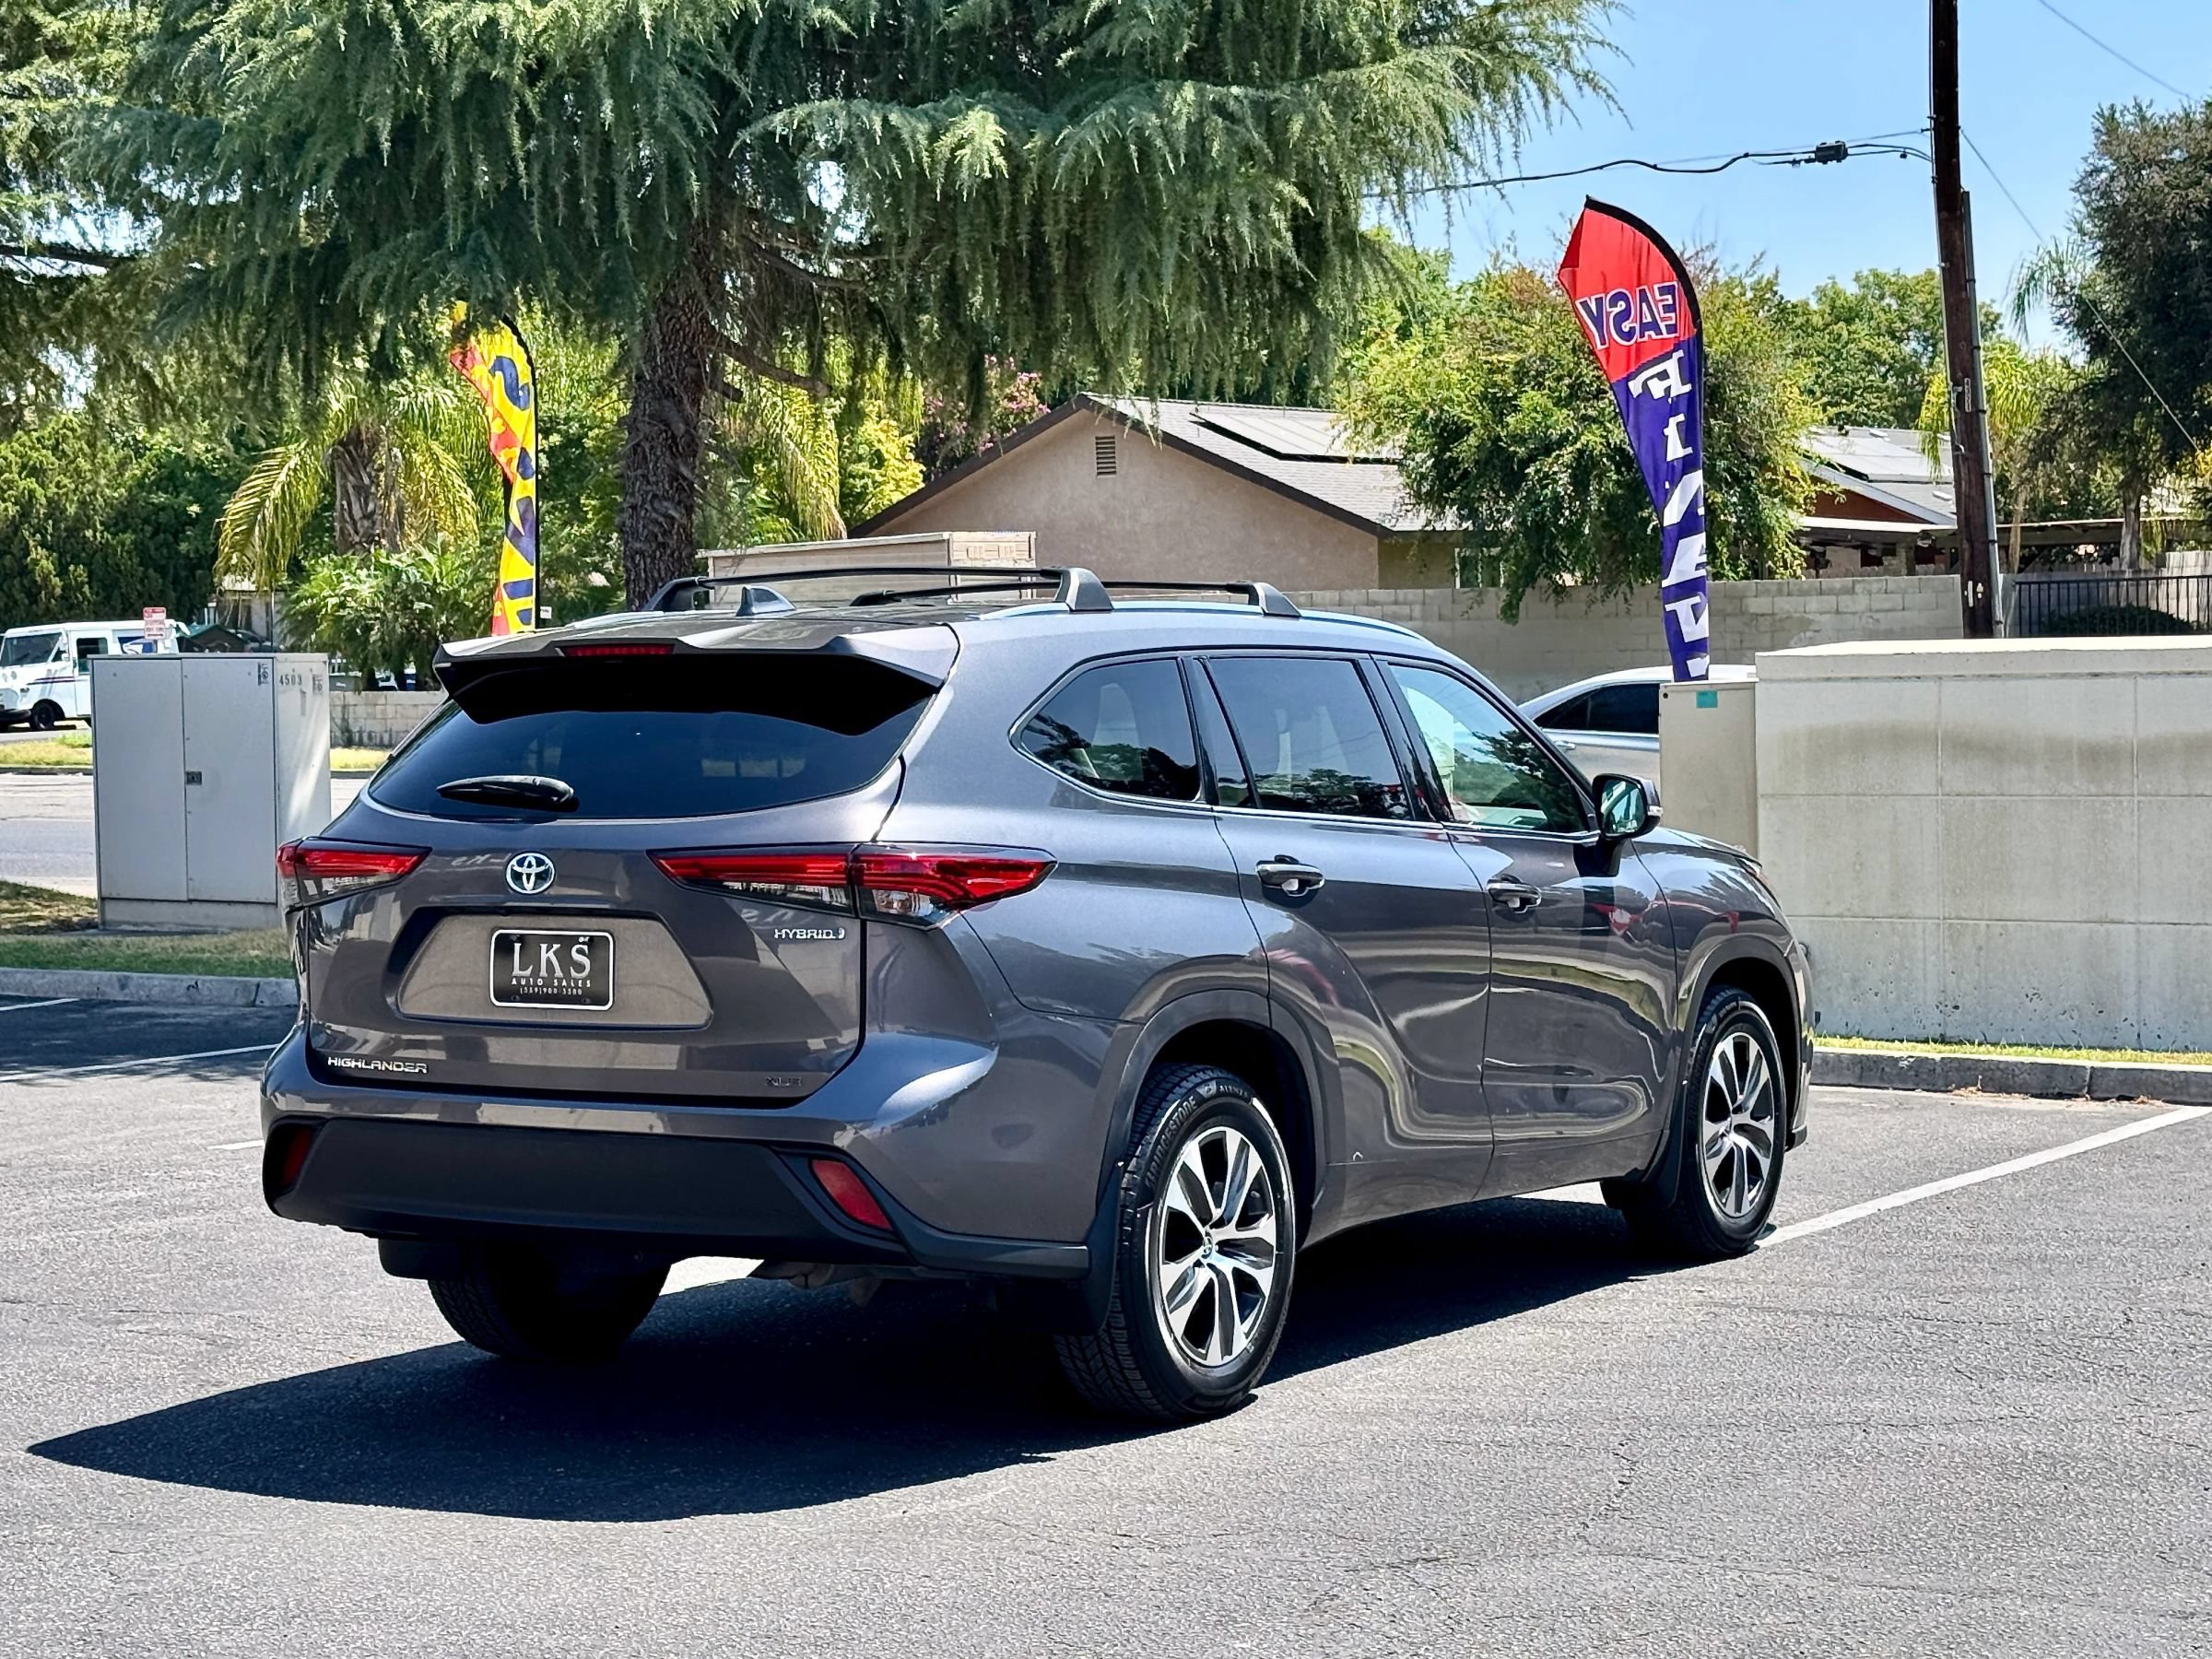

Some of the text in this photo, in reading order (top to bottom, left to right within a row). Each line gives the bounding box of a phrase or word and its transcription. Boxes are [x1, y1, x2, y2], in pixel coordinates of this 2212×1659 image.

[279, 674, 302, 686] 4503
[774, 928, 836, 939] HYBRID
[512, 943, 591, 979] LKS
[512, 977, 591, 988] AUTO SALES
[327, 1056, 428, 1074] HIGHLANDER
